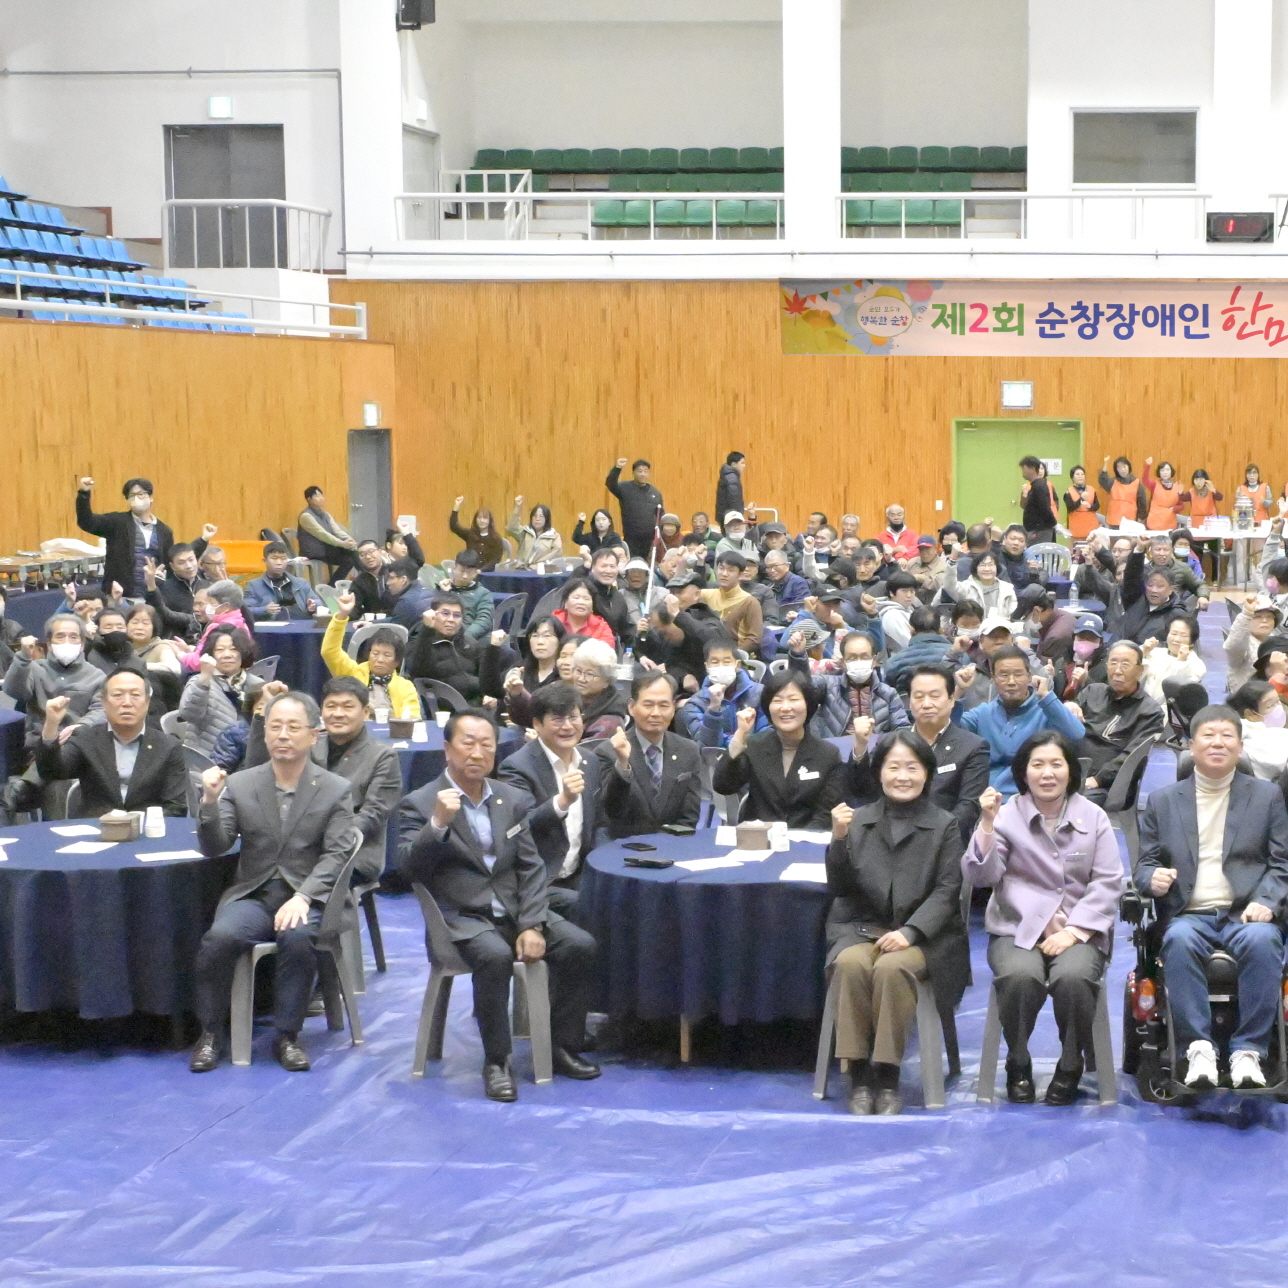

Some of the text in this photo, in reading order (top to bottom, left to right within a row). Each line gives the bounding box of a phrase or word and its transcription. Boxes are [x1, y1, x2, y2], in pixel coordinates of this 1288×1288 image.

[860, 315, 908, 326] 행복한 순창
[931, 302, 1025, 336] 제2회
[1035, 301, 1210, 340] 순창장애인
